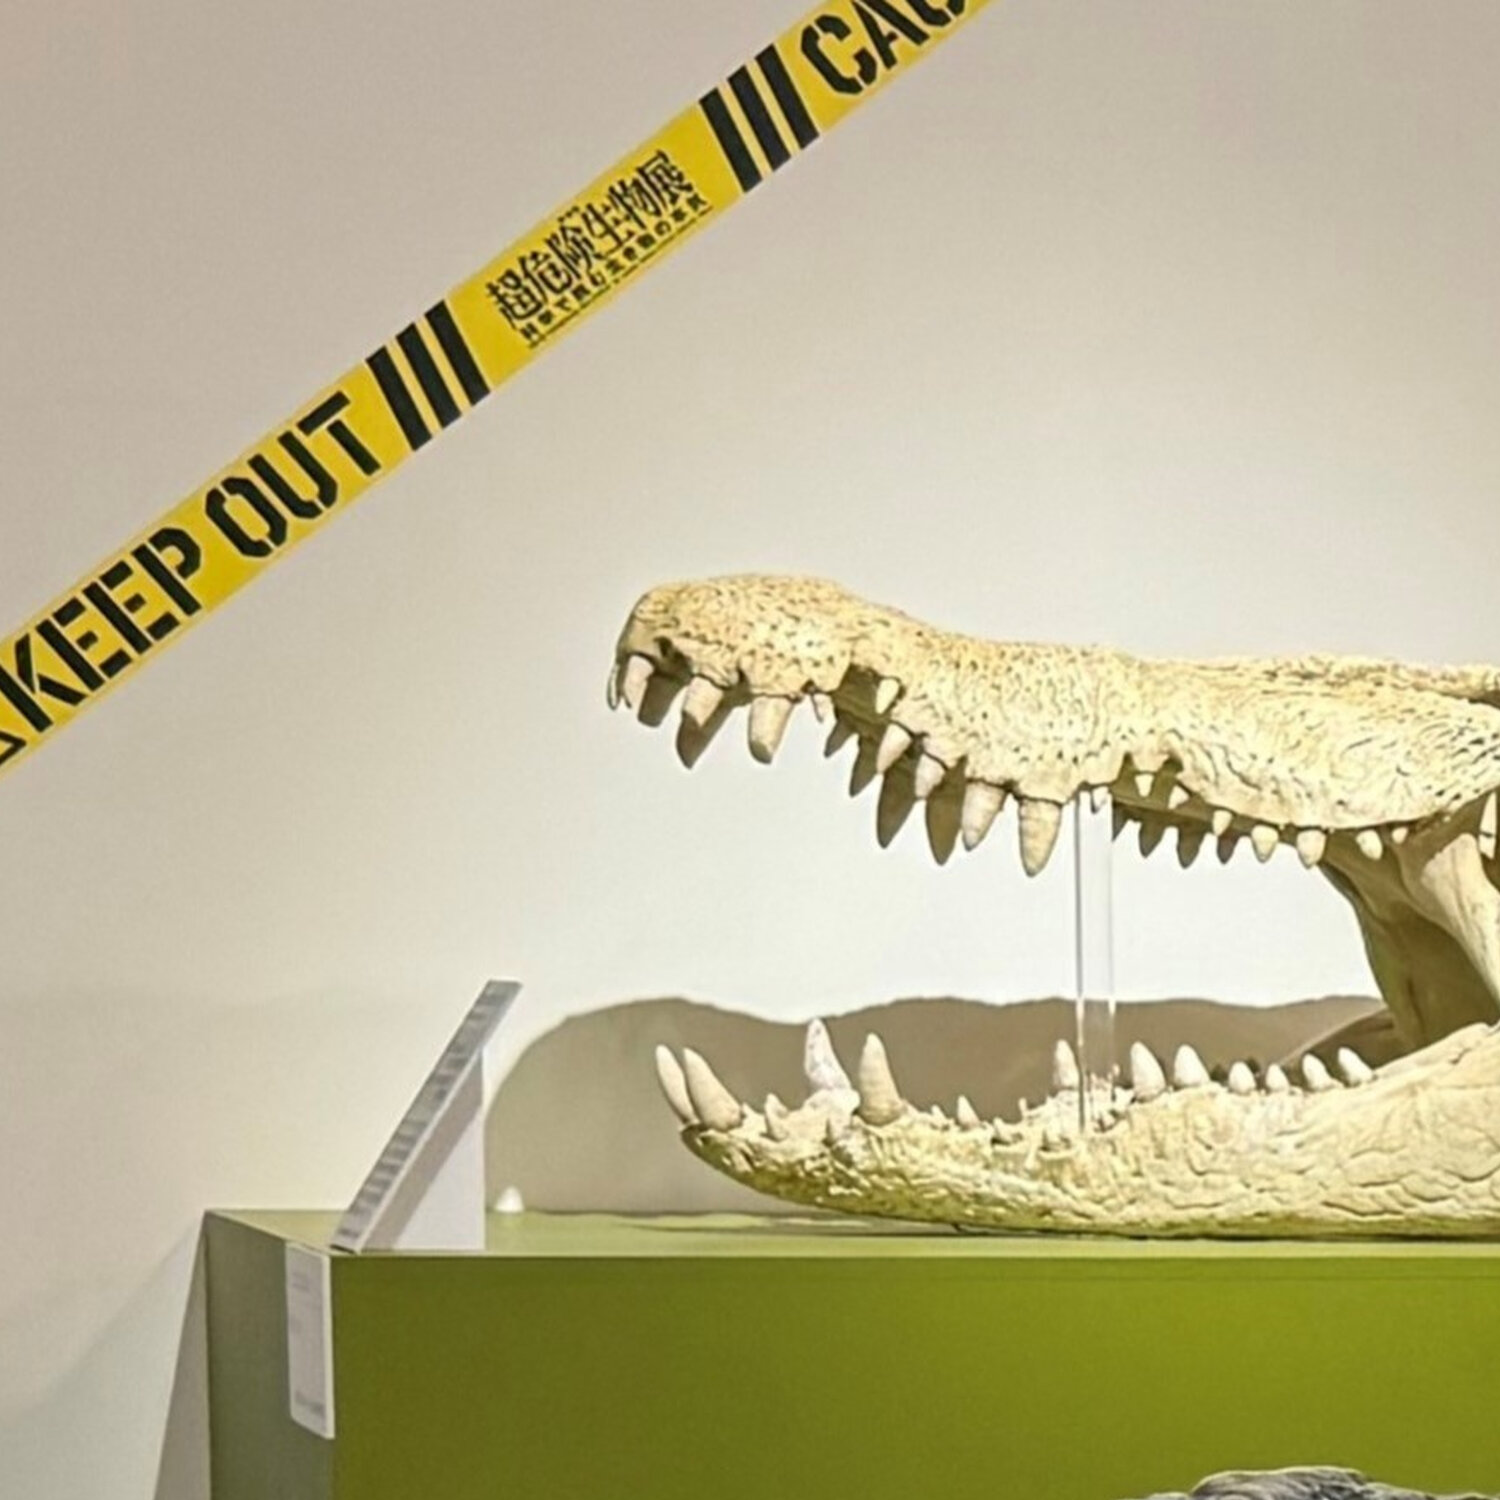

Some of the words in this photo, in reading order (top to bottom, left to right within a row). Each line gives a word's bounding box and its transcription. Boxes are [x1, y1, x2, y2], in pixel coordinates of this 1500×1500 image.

[486, 149, 694, 331] 超危険生物展
[0, 527, 202, 733] KEEP
[205, 390, 381, 558] OUT
